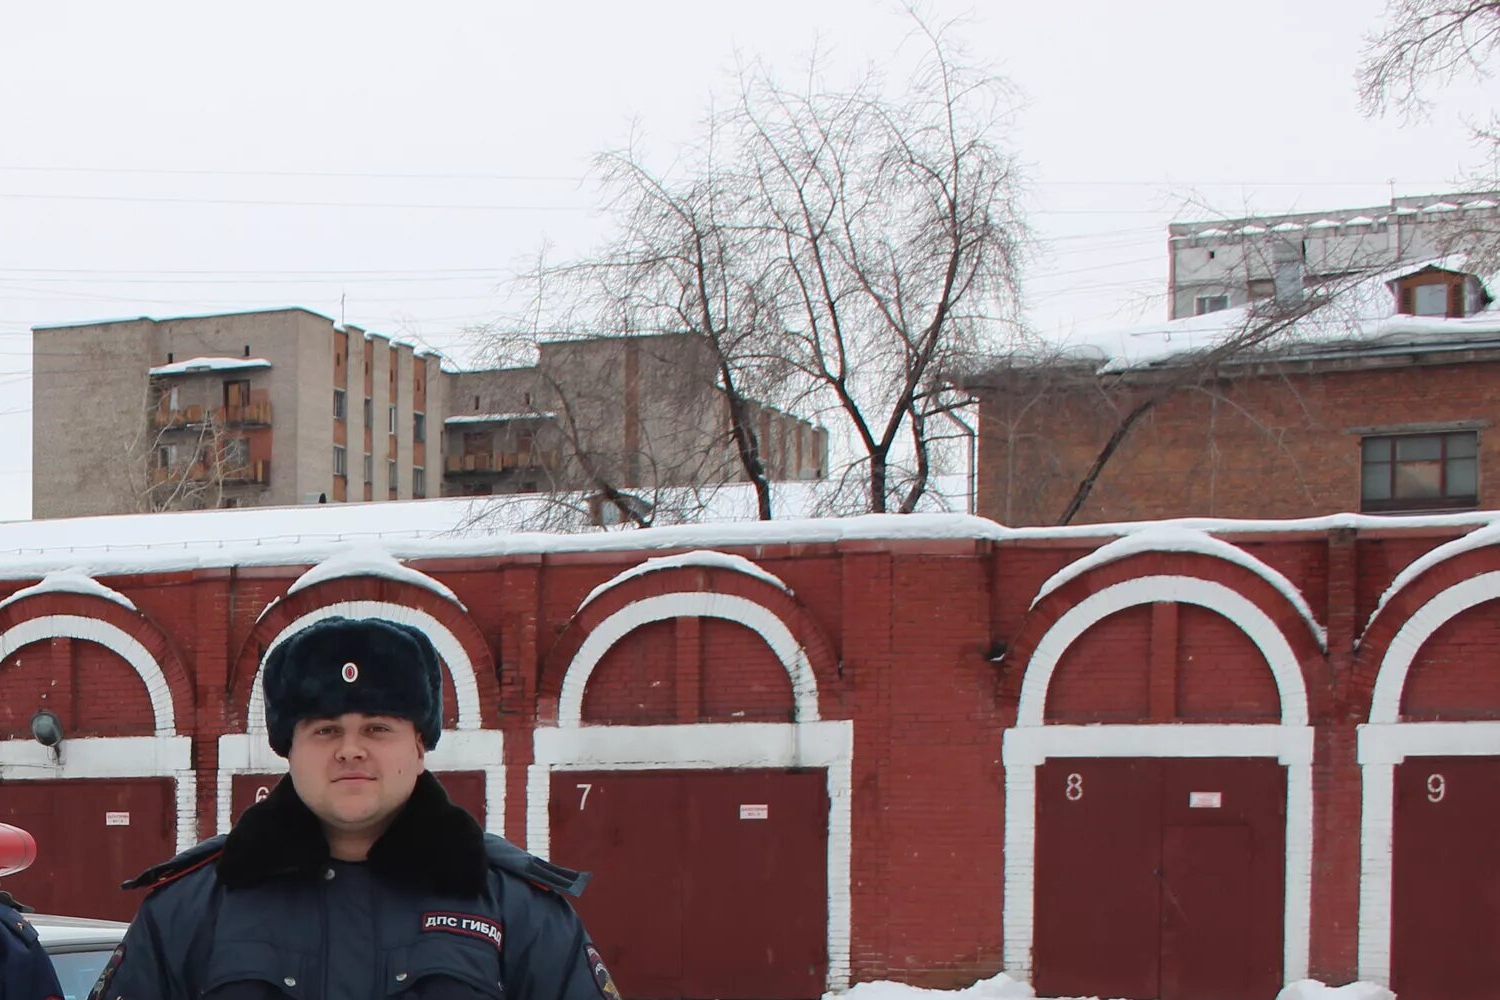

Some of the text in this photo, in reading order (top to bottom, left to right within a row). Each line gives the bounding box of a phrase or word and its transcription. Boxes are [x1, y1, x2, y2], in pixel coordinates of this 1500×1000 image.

[576, 783, 592, 811] 7
[1066, 773, 1083, 801] 8
[1427, 773, 1445, 803] 9
[425, 916, 502, 946] ДПС ГИБДД
